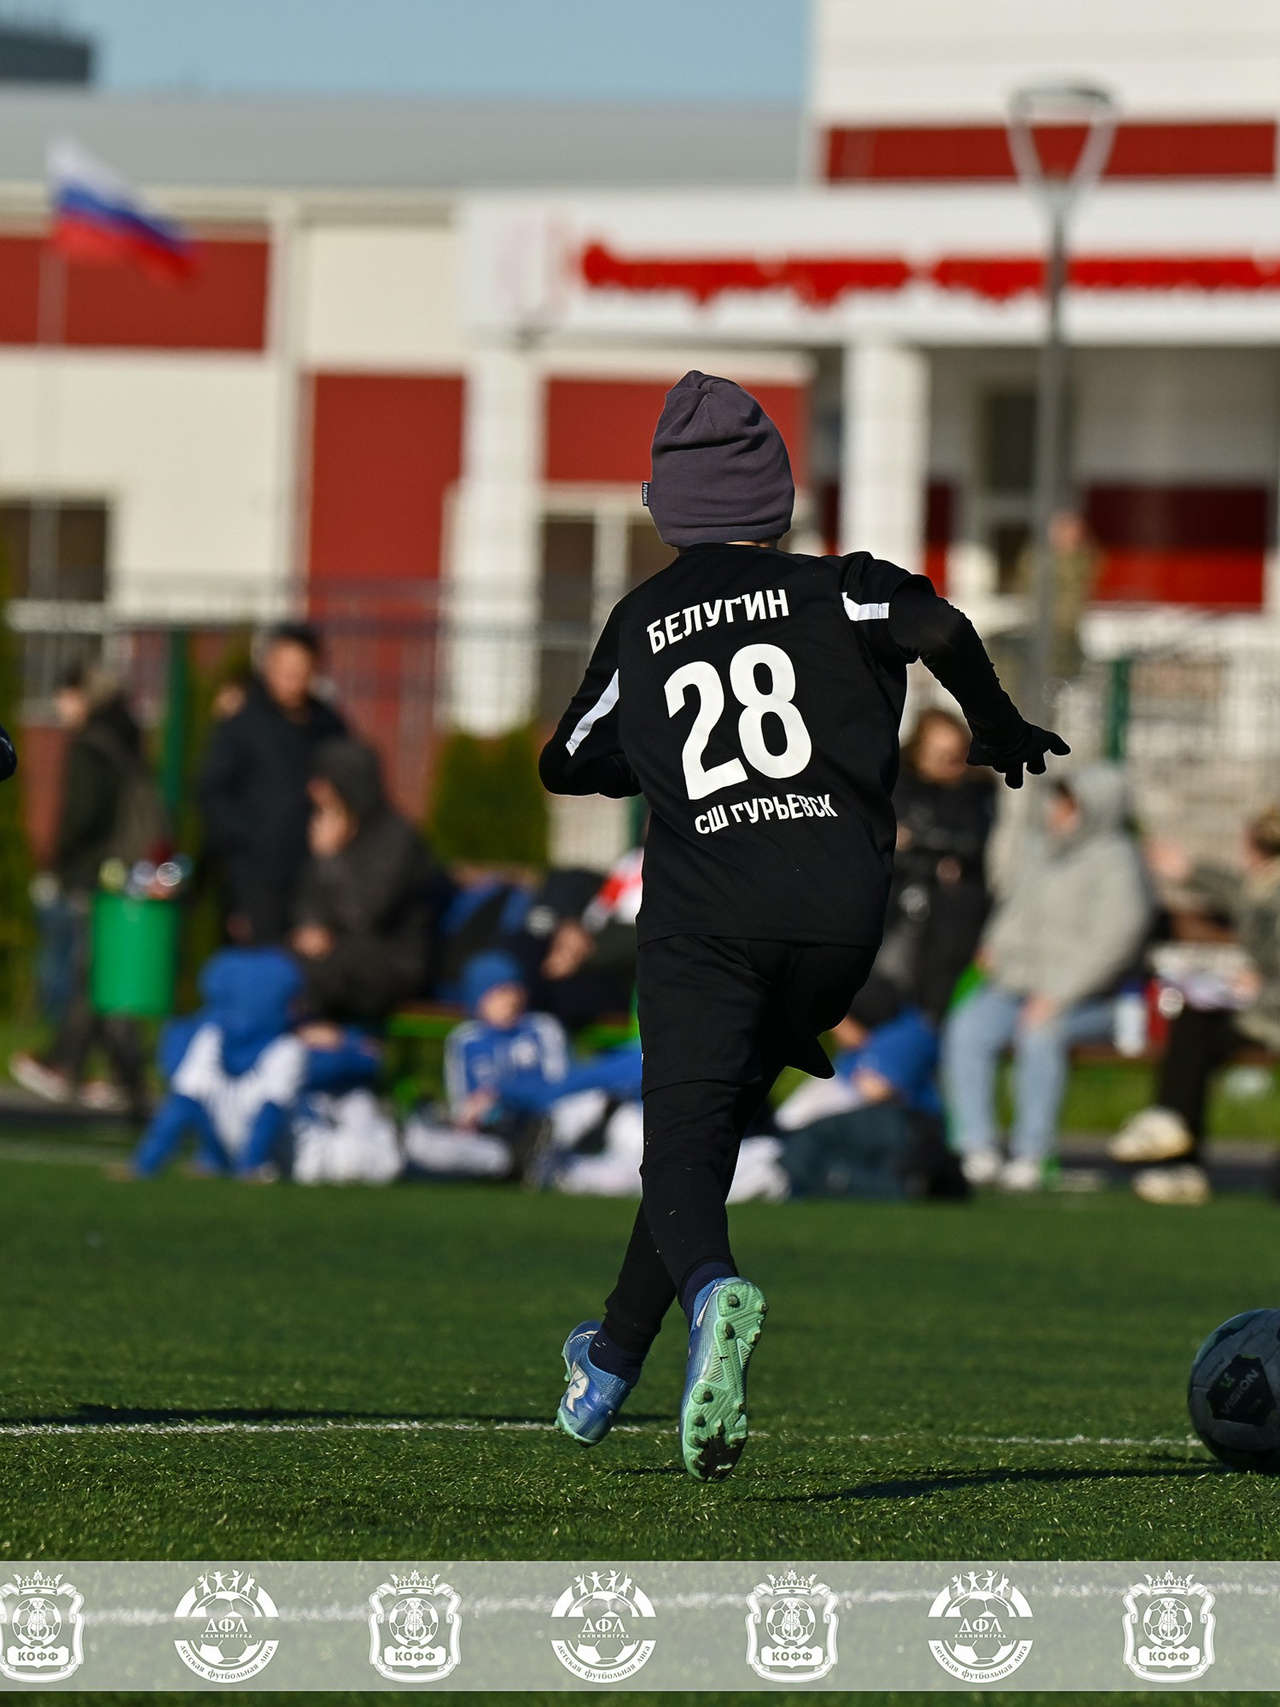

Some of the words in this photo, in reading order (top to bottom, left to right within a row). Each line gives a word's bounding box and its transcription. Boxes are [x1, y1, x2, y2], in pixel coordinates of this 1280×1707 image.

[646, 588, 790, 655] БЕЛУГИН
[663, 643, 812, 801] 28
[694, 805, 730, 835] СШ
[730, 793, 839, 824] ГУРЬЕВСК
[1219, 1368, 1260, 1415] VISION
